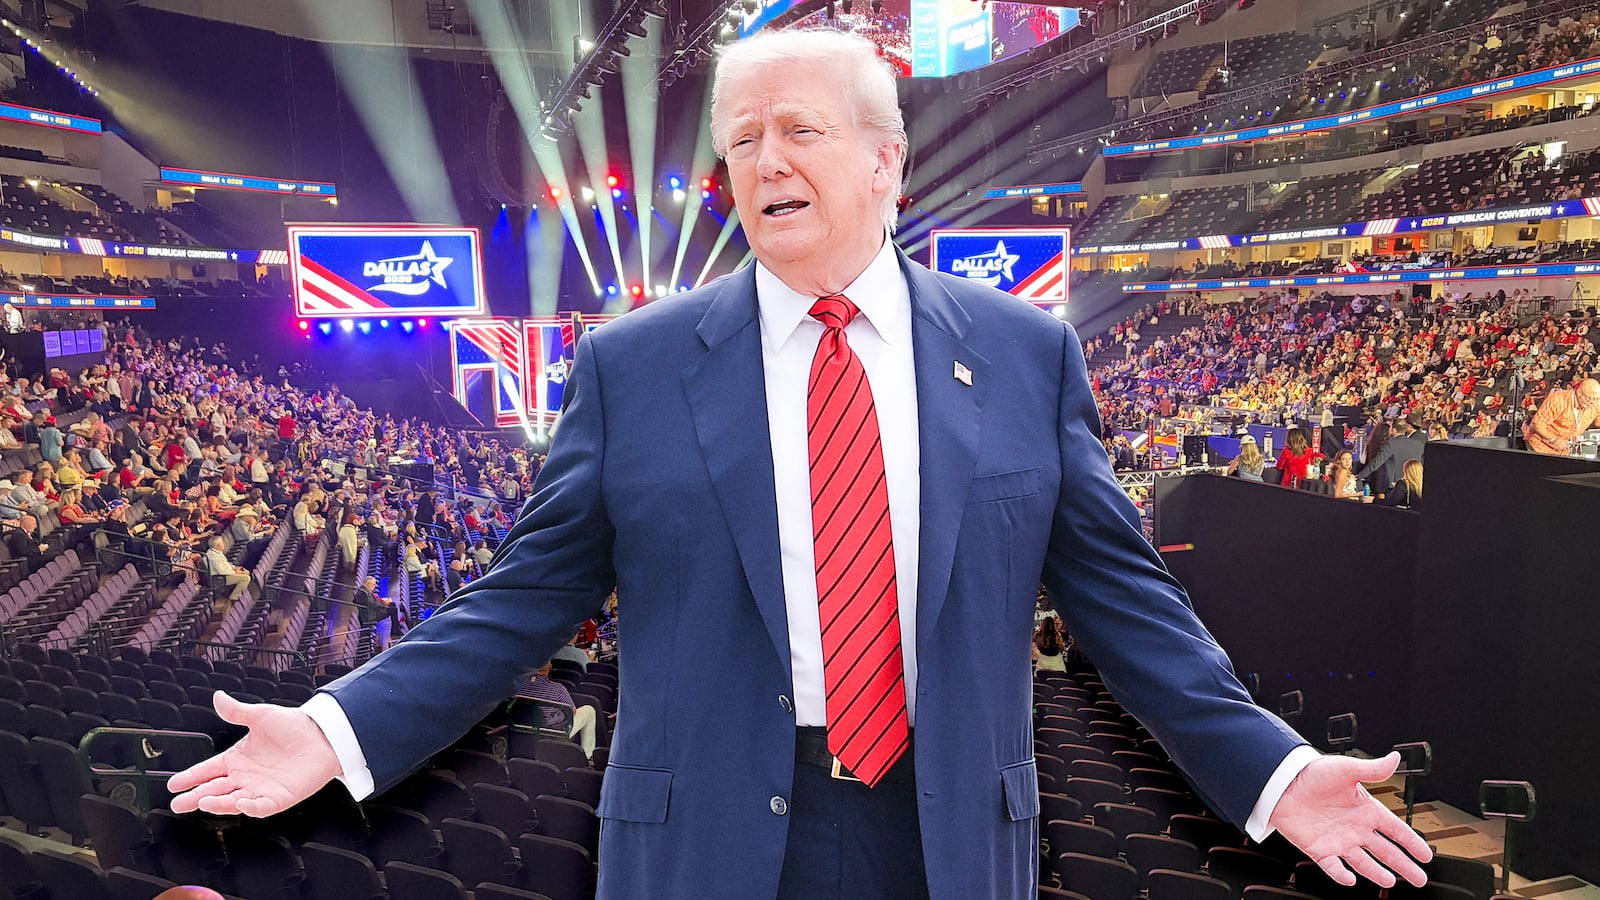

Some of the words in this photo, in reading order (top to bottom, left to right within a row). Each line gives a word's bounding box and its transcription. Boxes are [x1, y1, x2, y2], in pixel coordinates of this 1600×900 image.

[1446, 212, 1497, 225] REPUBLICAN
[1497, 206, 1553, 219] CONVENTION
[1302, 228, 1340, 238] CONVENTION
[147, 247, 187, 258] REPUBLICAN
[187, 249, 228, 260] CONVENTION
[1101, 243, 1141, 254] REPUBLICAN
[1141, 240, 1181, 252] CONVENTION
[363, 261, 431, 276] DALLAS
[952, 258, 1004, 272] DALLAS
[1312, 431, 1320, 454] UTAH
